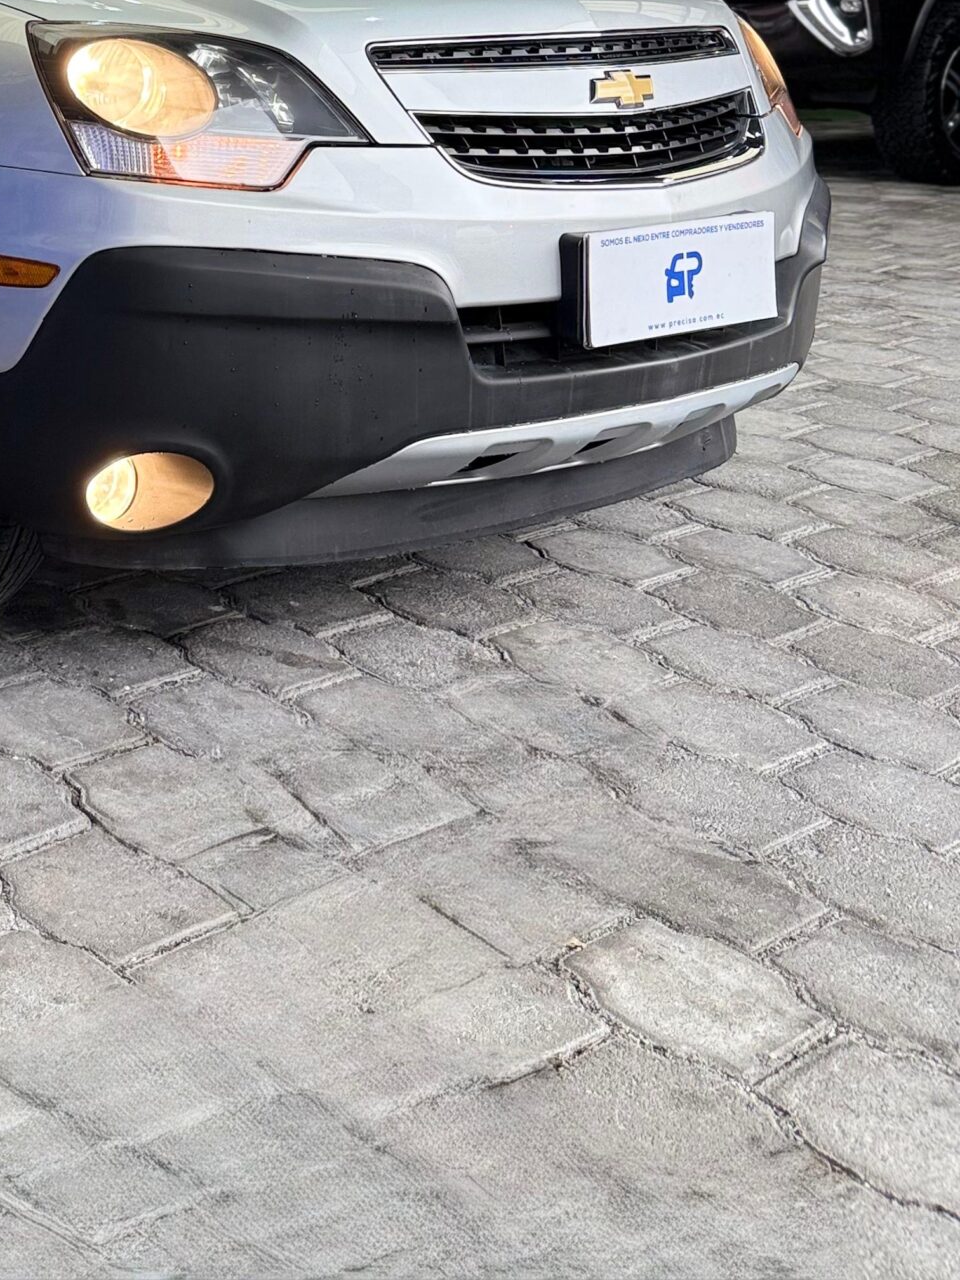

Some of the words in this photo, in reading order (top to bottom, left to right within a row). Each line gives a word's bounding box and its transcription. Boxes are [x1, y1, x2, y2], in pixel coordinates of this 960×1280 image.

[600, 236, 624, 247] SOMOS
[624, 235, 633, 244] EL
[633, 233, 650, 243] NEXO
[650, 231, 671, 241] ENTRE
[671, 225, 718, 238] COMPRADORES
[724, 219, 765, 231] VENDEDORES
